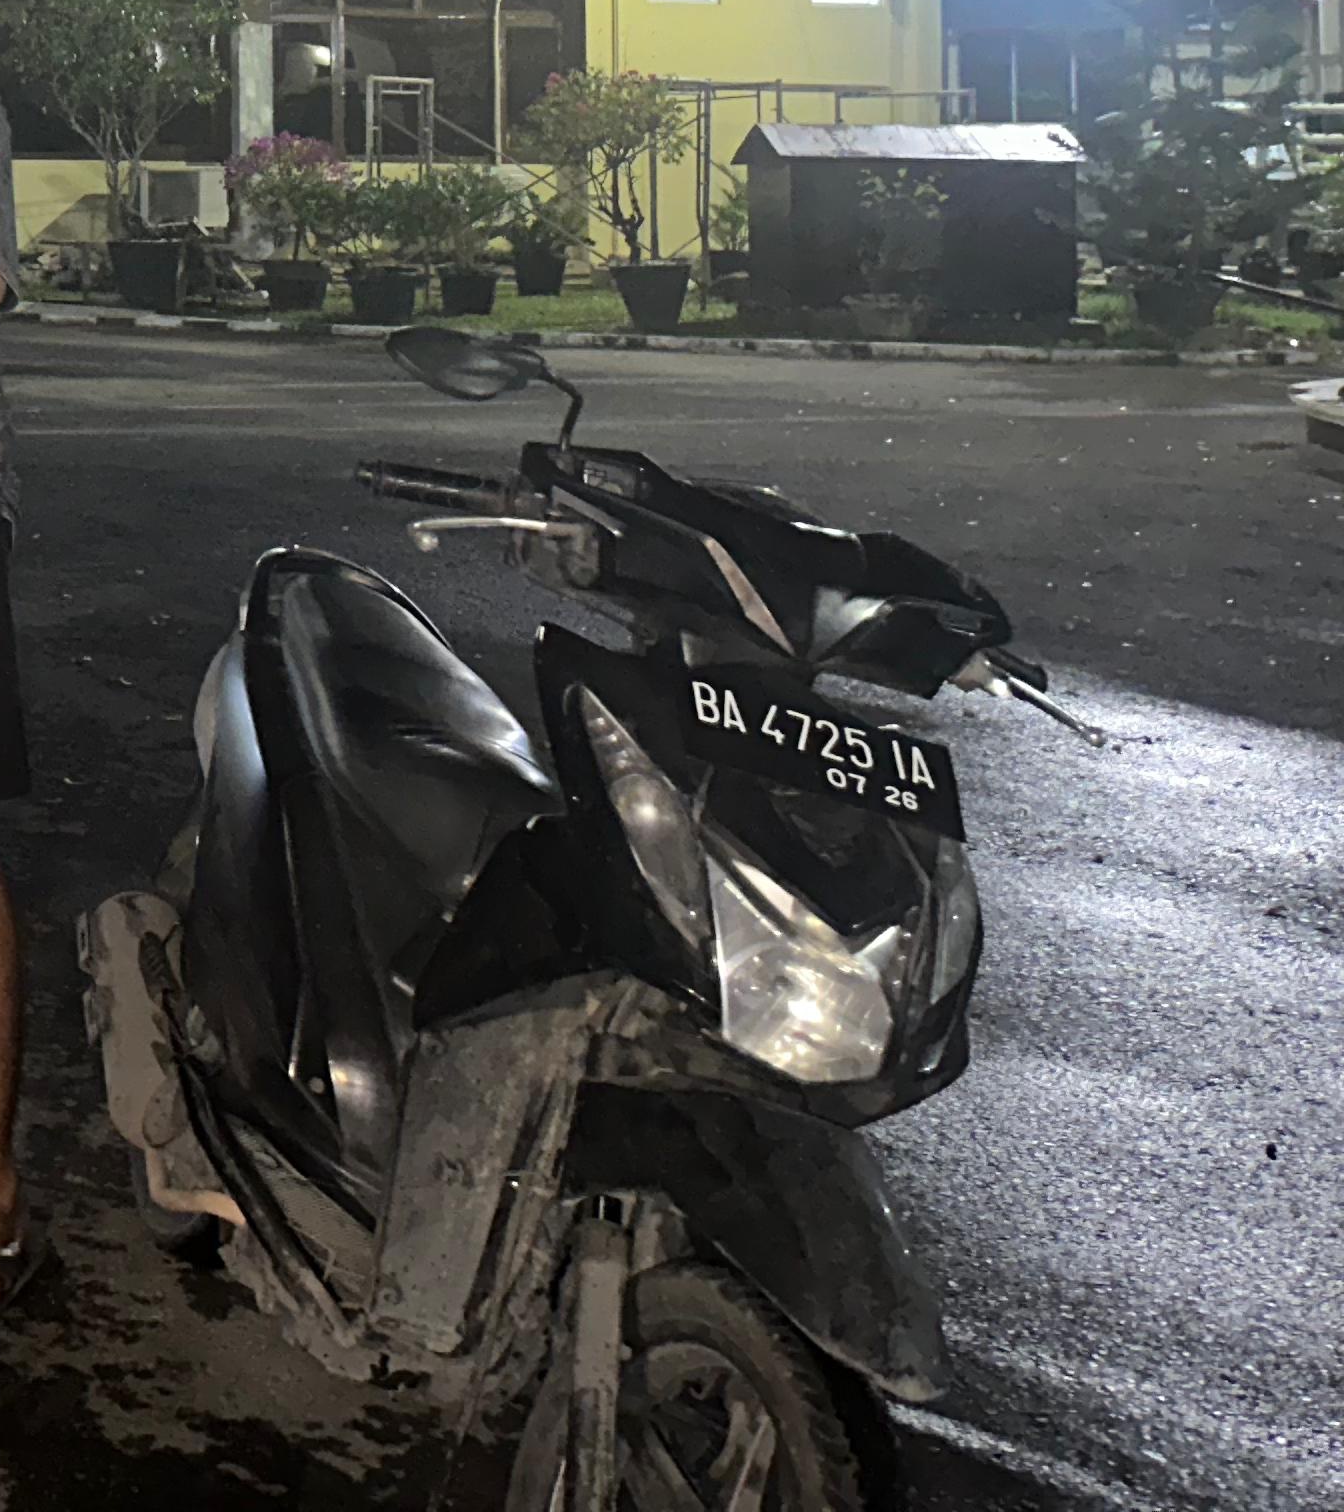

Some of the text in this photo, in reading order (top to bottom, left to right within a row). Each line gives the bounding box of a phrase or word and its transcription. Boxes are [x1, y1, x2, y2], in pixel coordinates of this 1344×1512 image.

[691, 681, 747, 734] BA
[761, 704, 873, 769] 4725
[825, 767, 919, 811] 07 26
